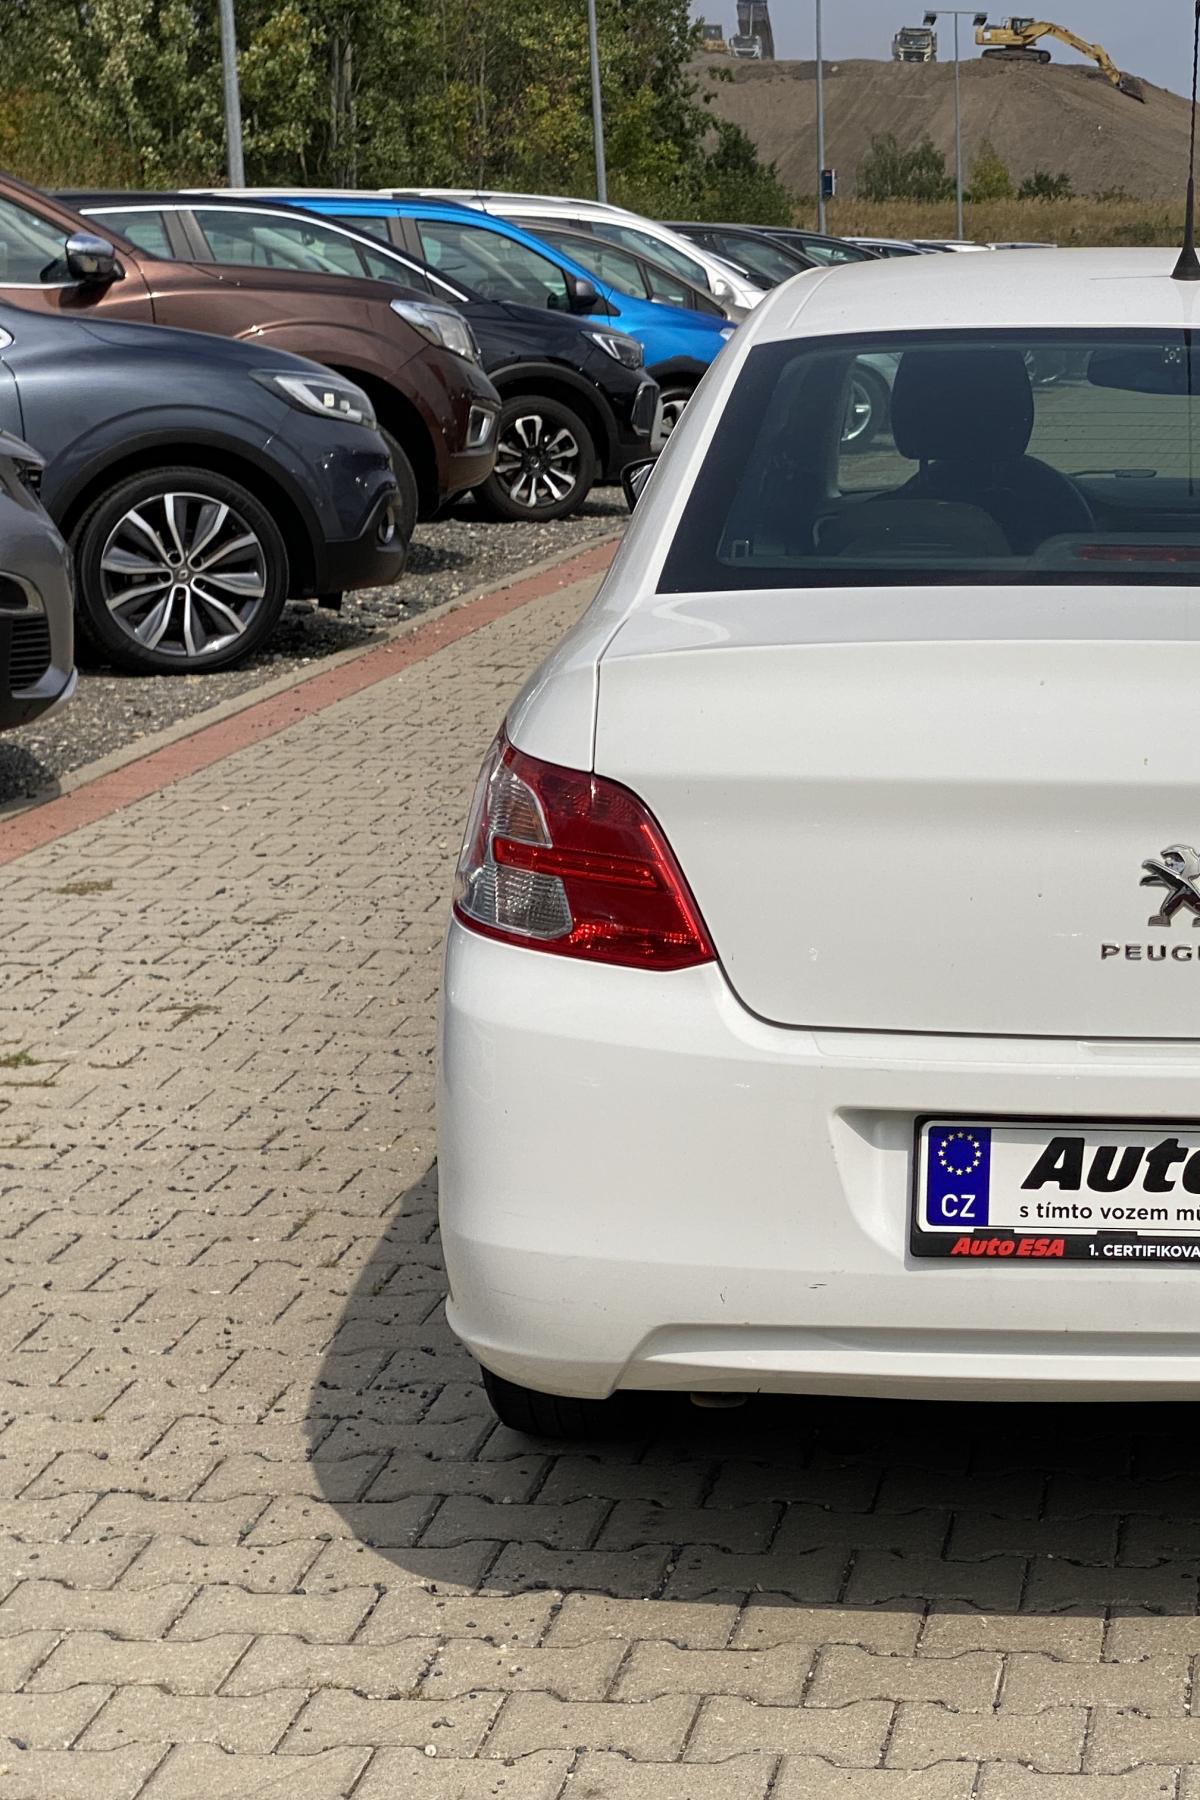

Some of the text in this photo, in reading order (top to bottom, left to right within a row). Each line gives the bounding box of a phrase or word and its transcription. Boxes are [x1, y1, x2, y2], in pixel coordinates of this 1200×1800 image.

[941, 1193, 976, 1218] CZ
[1019, 1205, 1029, 1218] s
[1037, 1202, 1093, 1219] tímto
[1100, 1206, 1168, 1221] vozem
[951, 1237, 1064, 1257] Auto ESA
[1089, 1244, 1099, 1257] 1.
